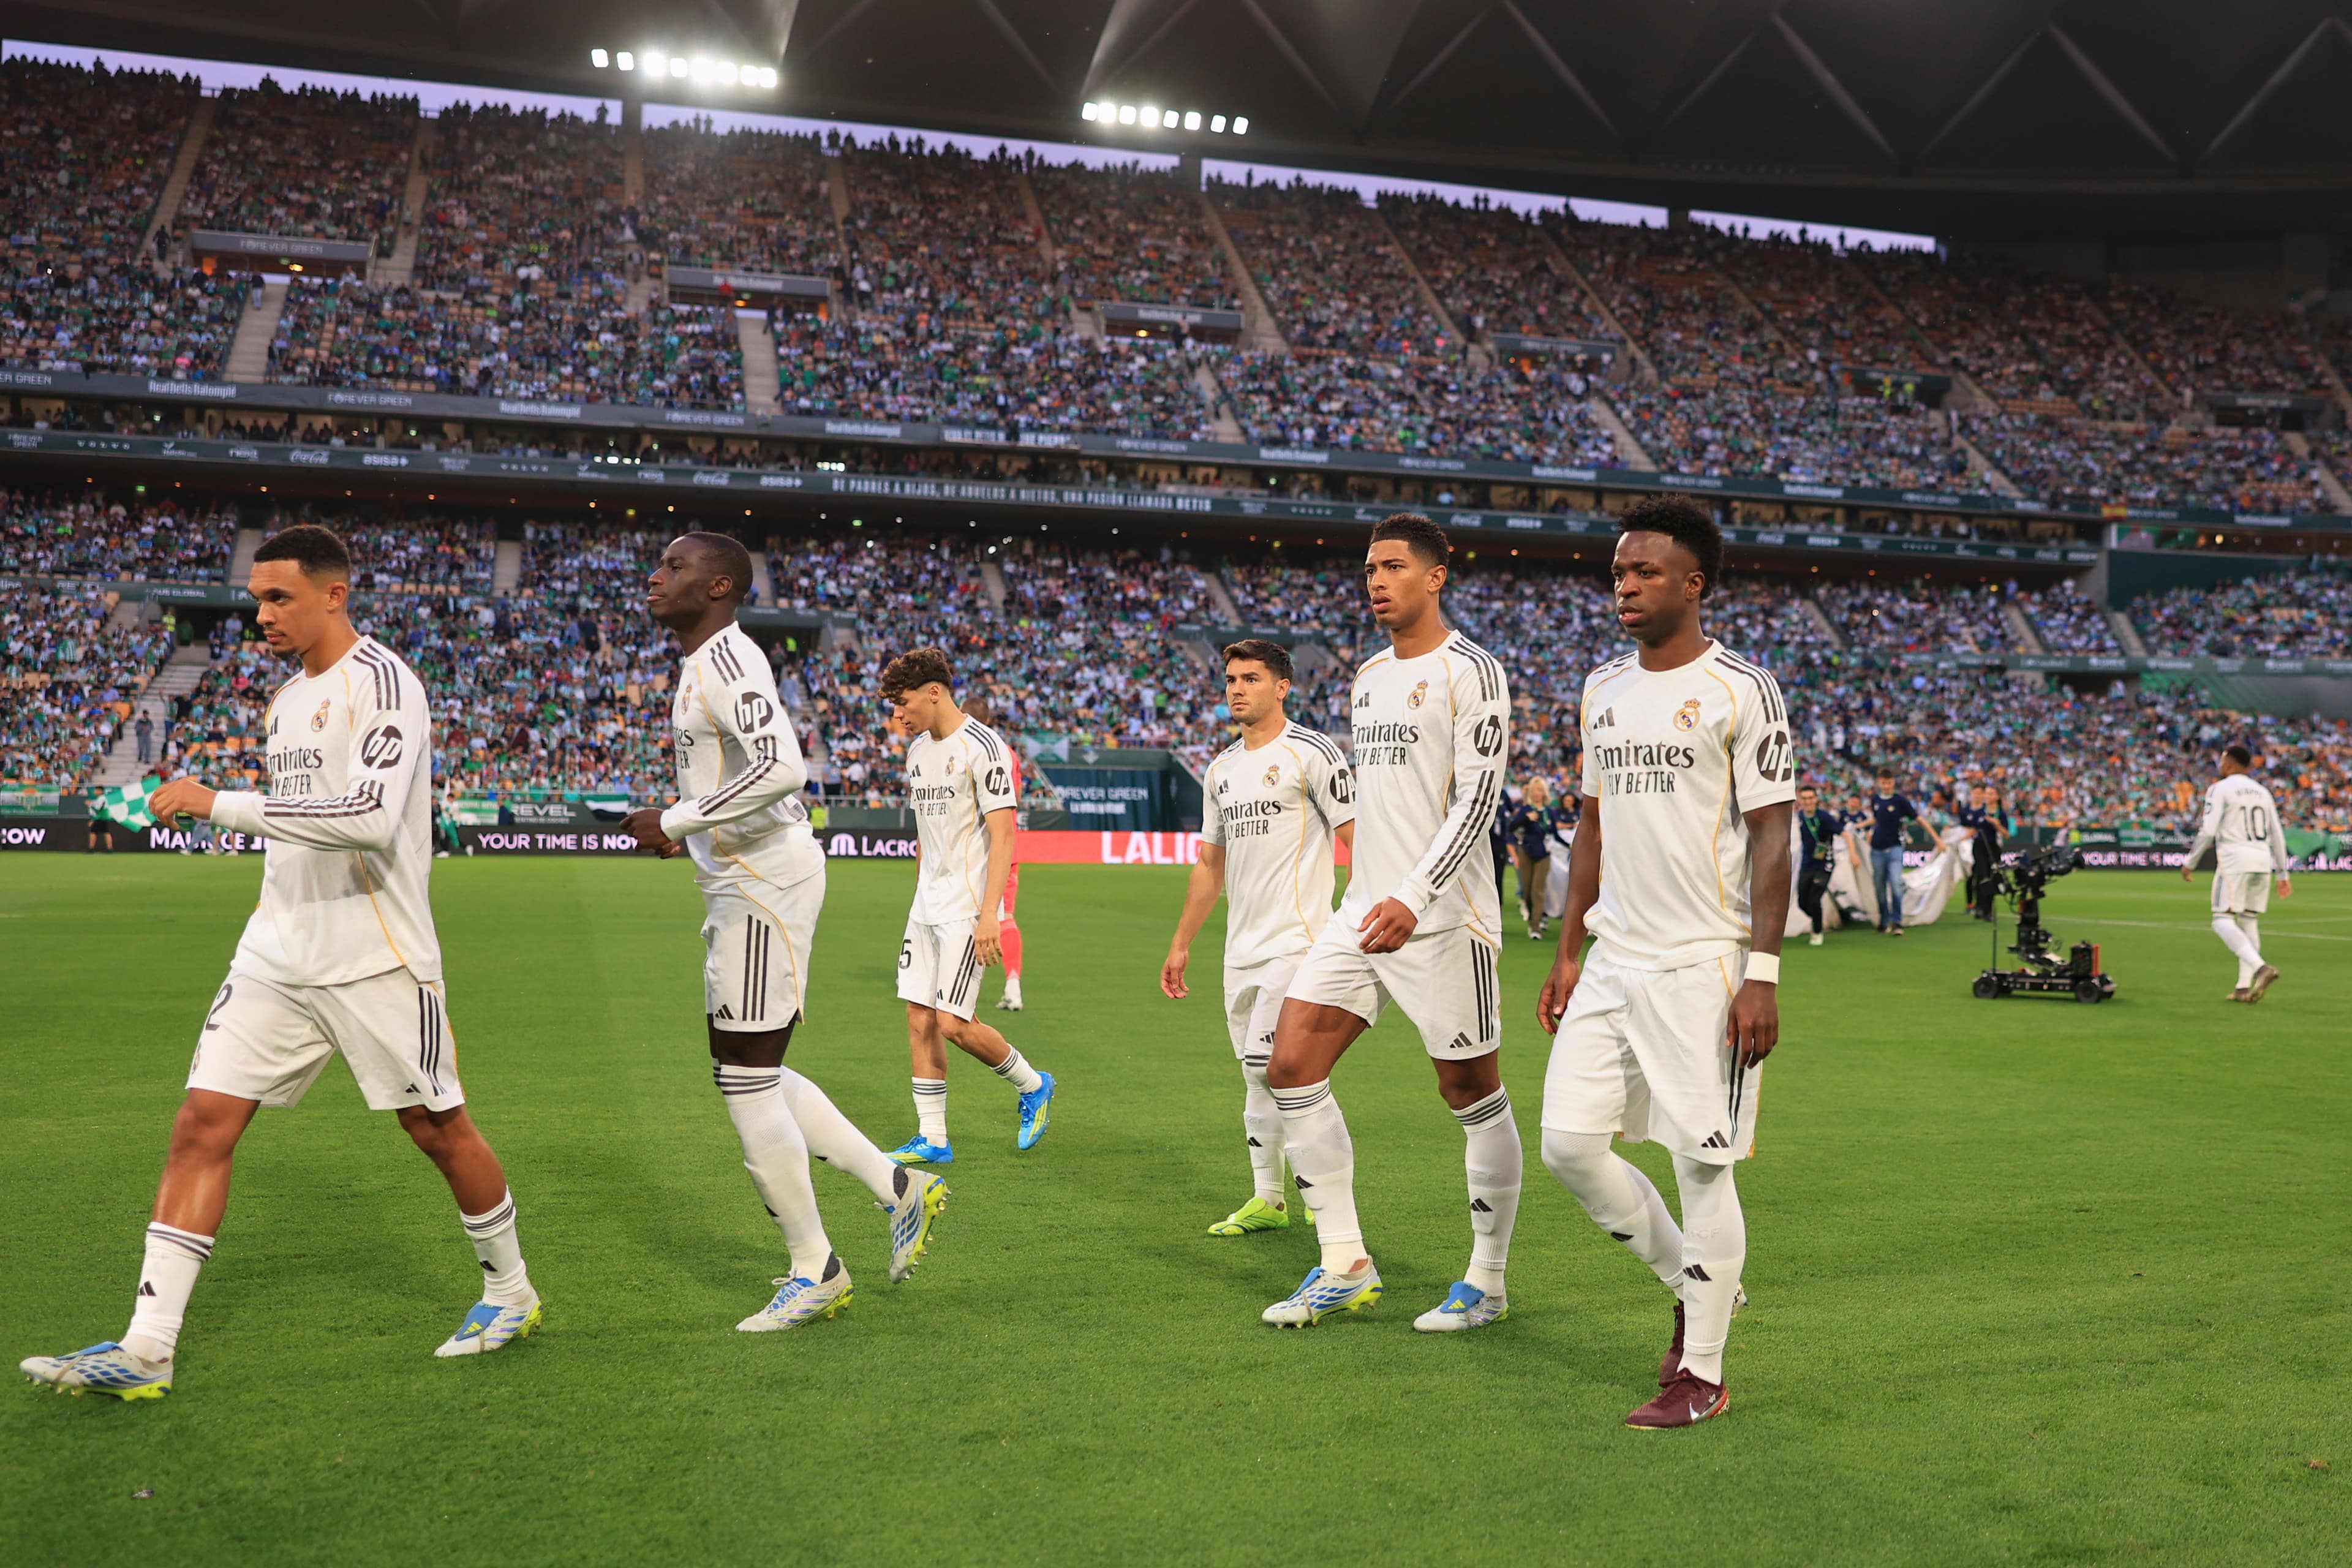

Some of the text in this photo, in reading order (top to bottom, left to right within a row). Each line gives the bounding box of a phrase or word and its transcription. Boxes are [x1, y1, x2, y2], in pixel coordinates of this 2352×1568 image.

[735, 692, 773, 734] hp
[361, 725, 402, 769] hp
[1594, 739, 1695, 771] Emirates
[1608, 771, 1675, 796] FLY BETTER
[511, 803, 576, 816] REVEL
[1221, 799, 1281, 824] mirates
[0, 827, 46, 845] OW
[1235, 820, 1268, 839] BETTER
[2239, 805, 2267, 842] 10
[478, 832, 530, 850] YOUR
[535, 834, 578, 850] TIME
[582, 834, 598, 850] IS
[2082, 851, 2118, 866] YOUR
[2120, 851, 2149, 866] TIME
[899, 939, 911, 970] 5
[205, 983, 233, 1031] 2
